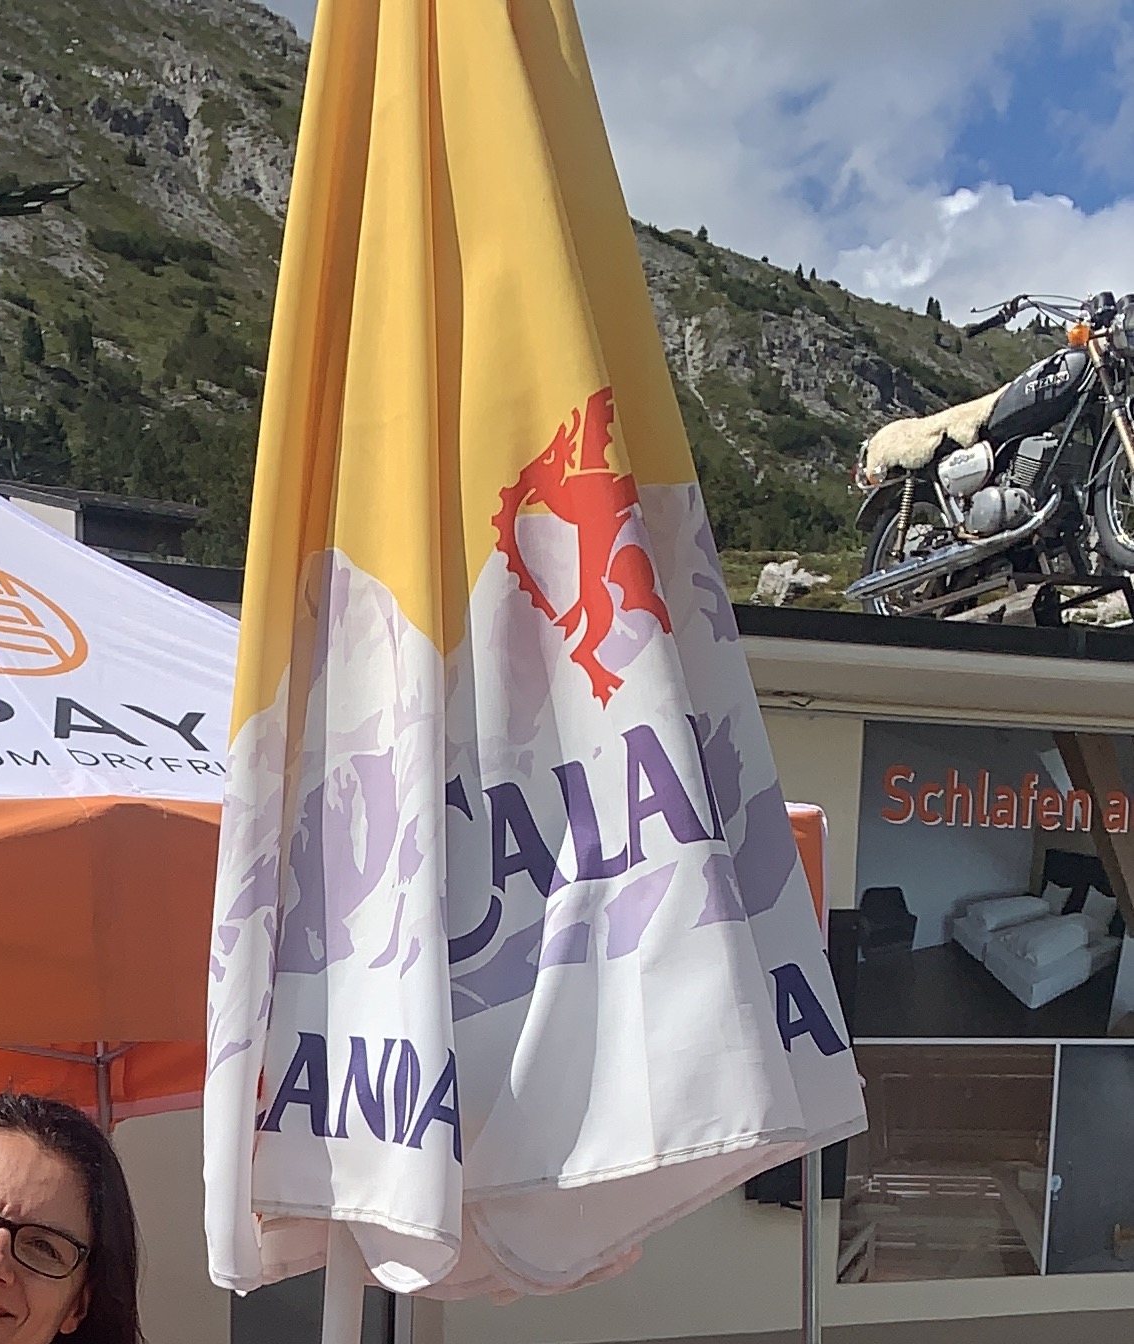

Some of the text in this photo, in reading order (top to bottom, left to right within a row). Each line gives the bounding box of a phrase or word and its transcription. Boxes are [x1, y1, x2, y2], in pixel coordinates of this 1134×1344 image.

[445, 713, 726, 965] CALA
[881, 764, 1134, 834] Schlafen a
[256, 1031, 463, 1167] ANDA
